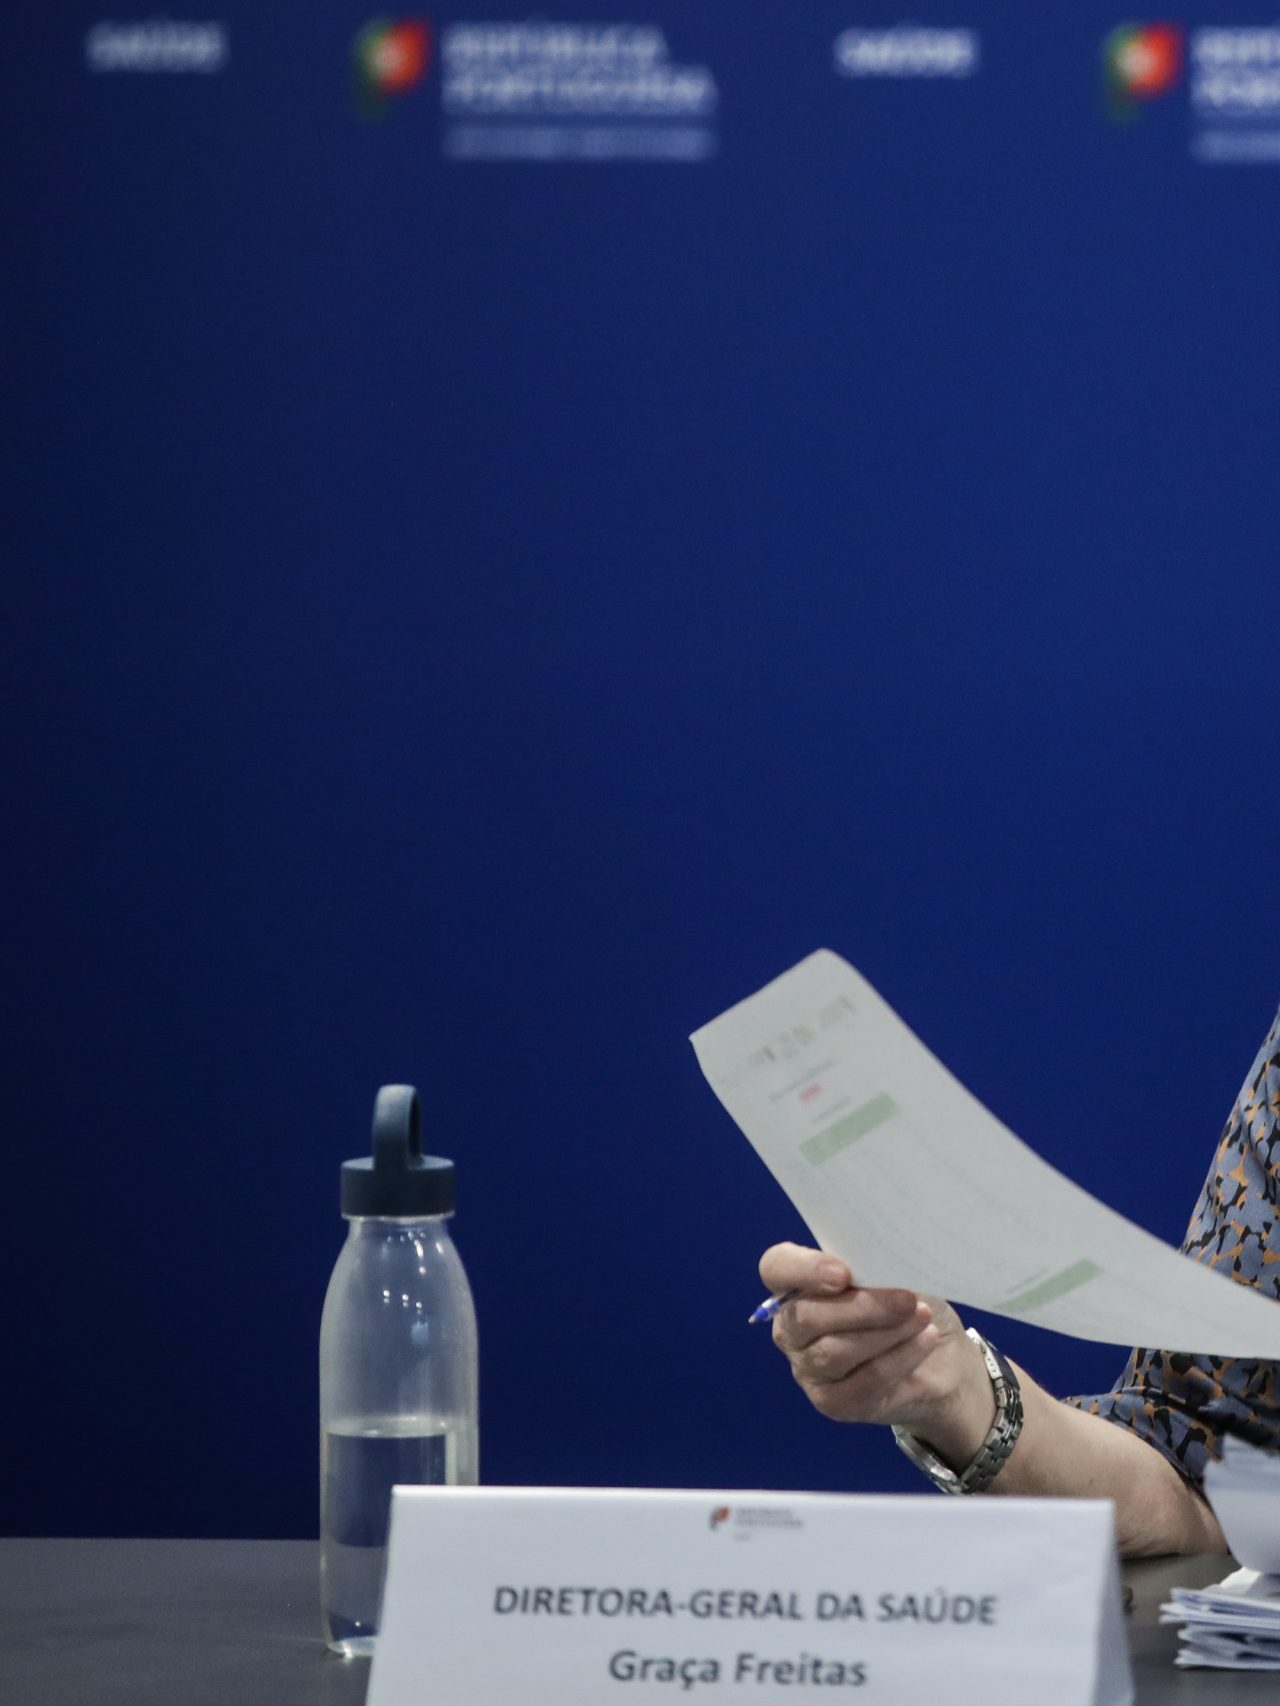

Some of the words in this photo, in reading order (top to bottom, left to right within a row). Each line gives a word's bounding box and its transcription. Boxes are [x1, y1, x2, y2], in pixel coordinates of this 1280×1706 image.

[493, 1585, 803, 1623] DIRETORA-GERAL
[816, 1592, 867, 1624] DA
[877, 1587, 998, 1627] SAÚDE
[608, 1650, 722, 1692] Graça
[734, 1652, 869, 1689] Freitas
